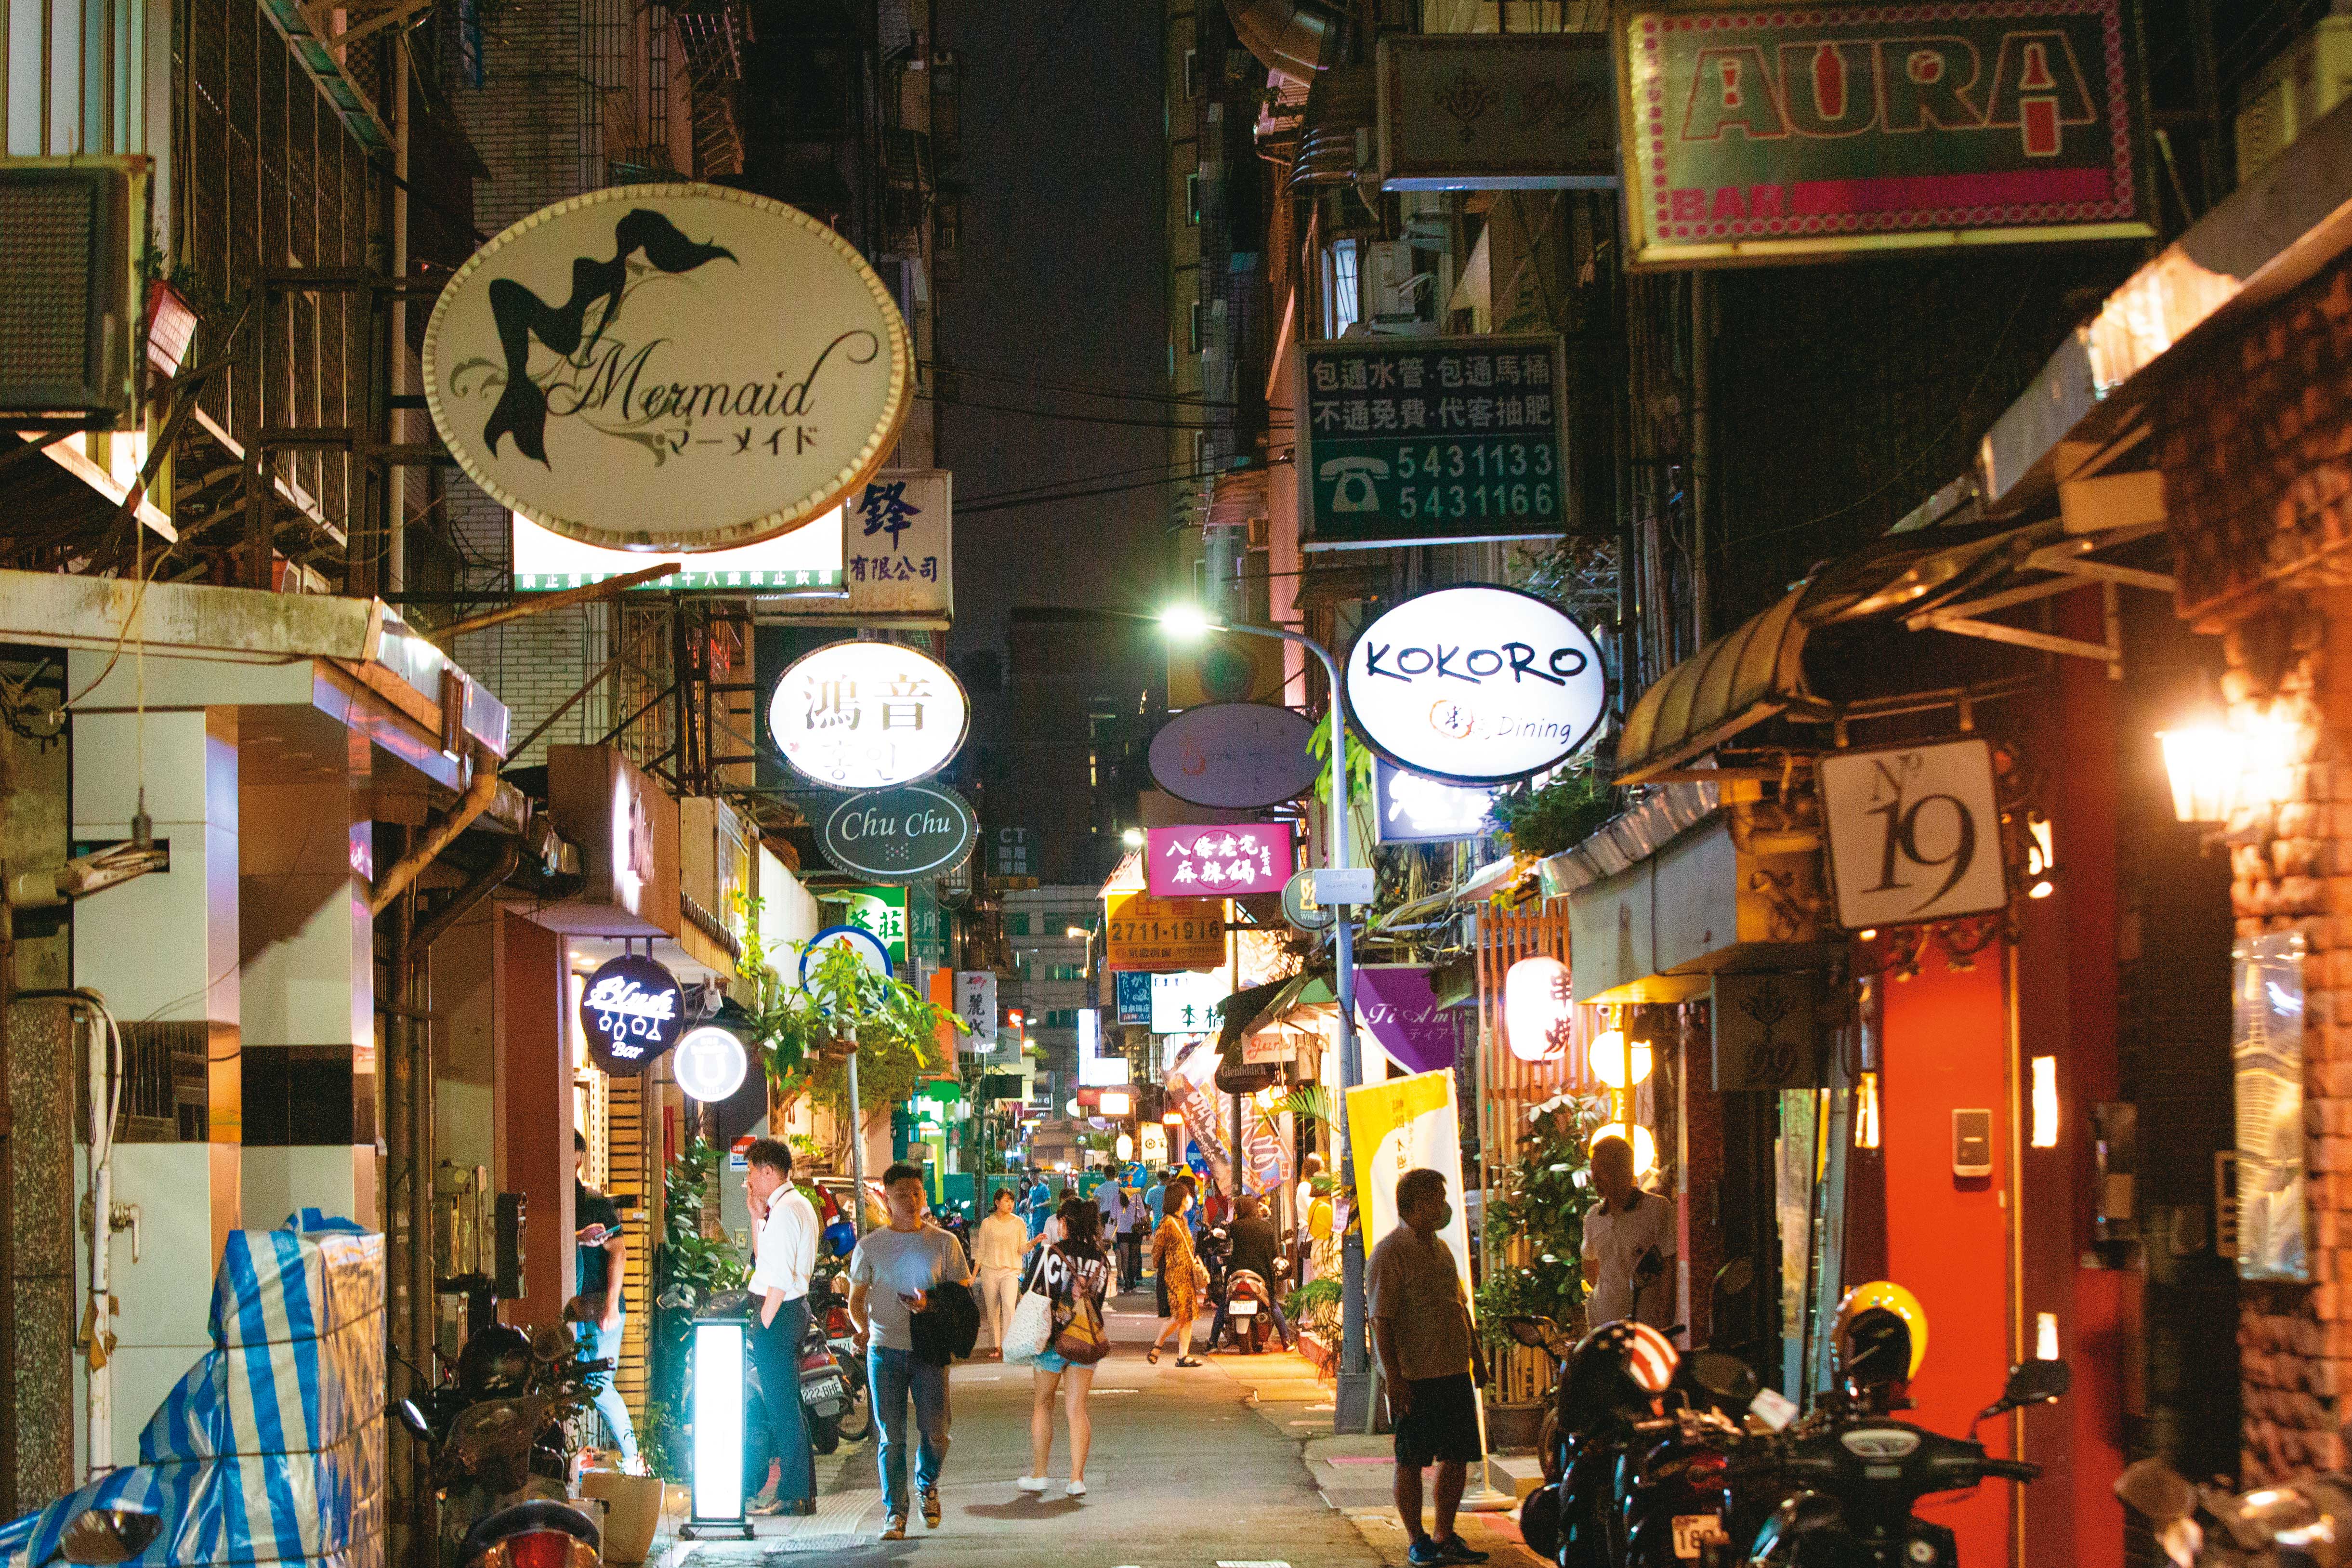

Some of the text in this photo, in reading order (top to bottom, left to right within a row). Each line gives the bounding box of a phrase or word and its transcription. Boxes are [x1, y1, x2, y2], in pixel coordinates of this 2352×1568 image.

[1680, 30, 2097, 157] AURA
[546, 329, 880, 420] Mermaid
[667, 426, 818, 457] マーメイド
[1397, 443, 1551, 479] 5431133
[1399, 482, 1554, 519] 5431166
[849, 554, 937, 583] 有限公司
[1367, 641, 1588, 686] KOKORO
[803, 673, 933, 731] 鴻音
[1496, 715, 1572, 745] Dining
[841, 807, 951, 841] Chu Chu
[1861, 792, 1976, 915] 19
[1365, 1002, 1398, 1025] Ti
[612, 1041, 644, 1060] Bar
